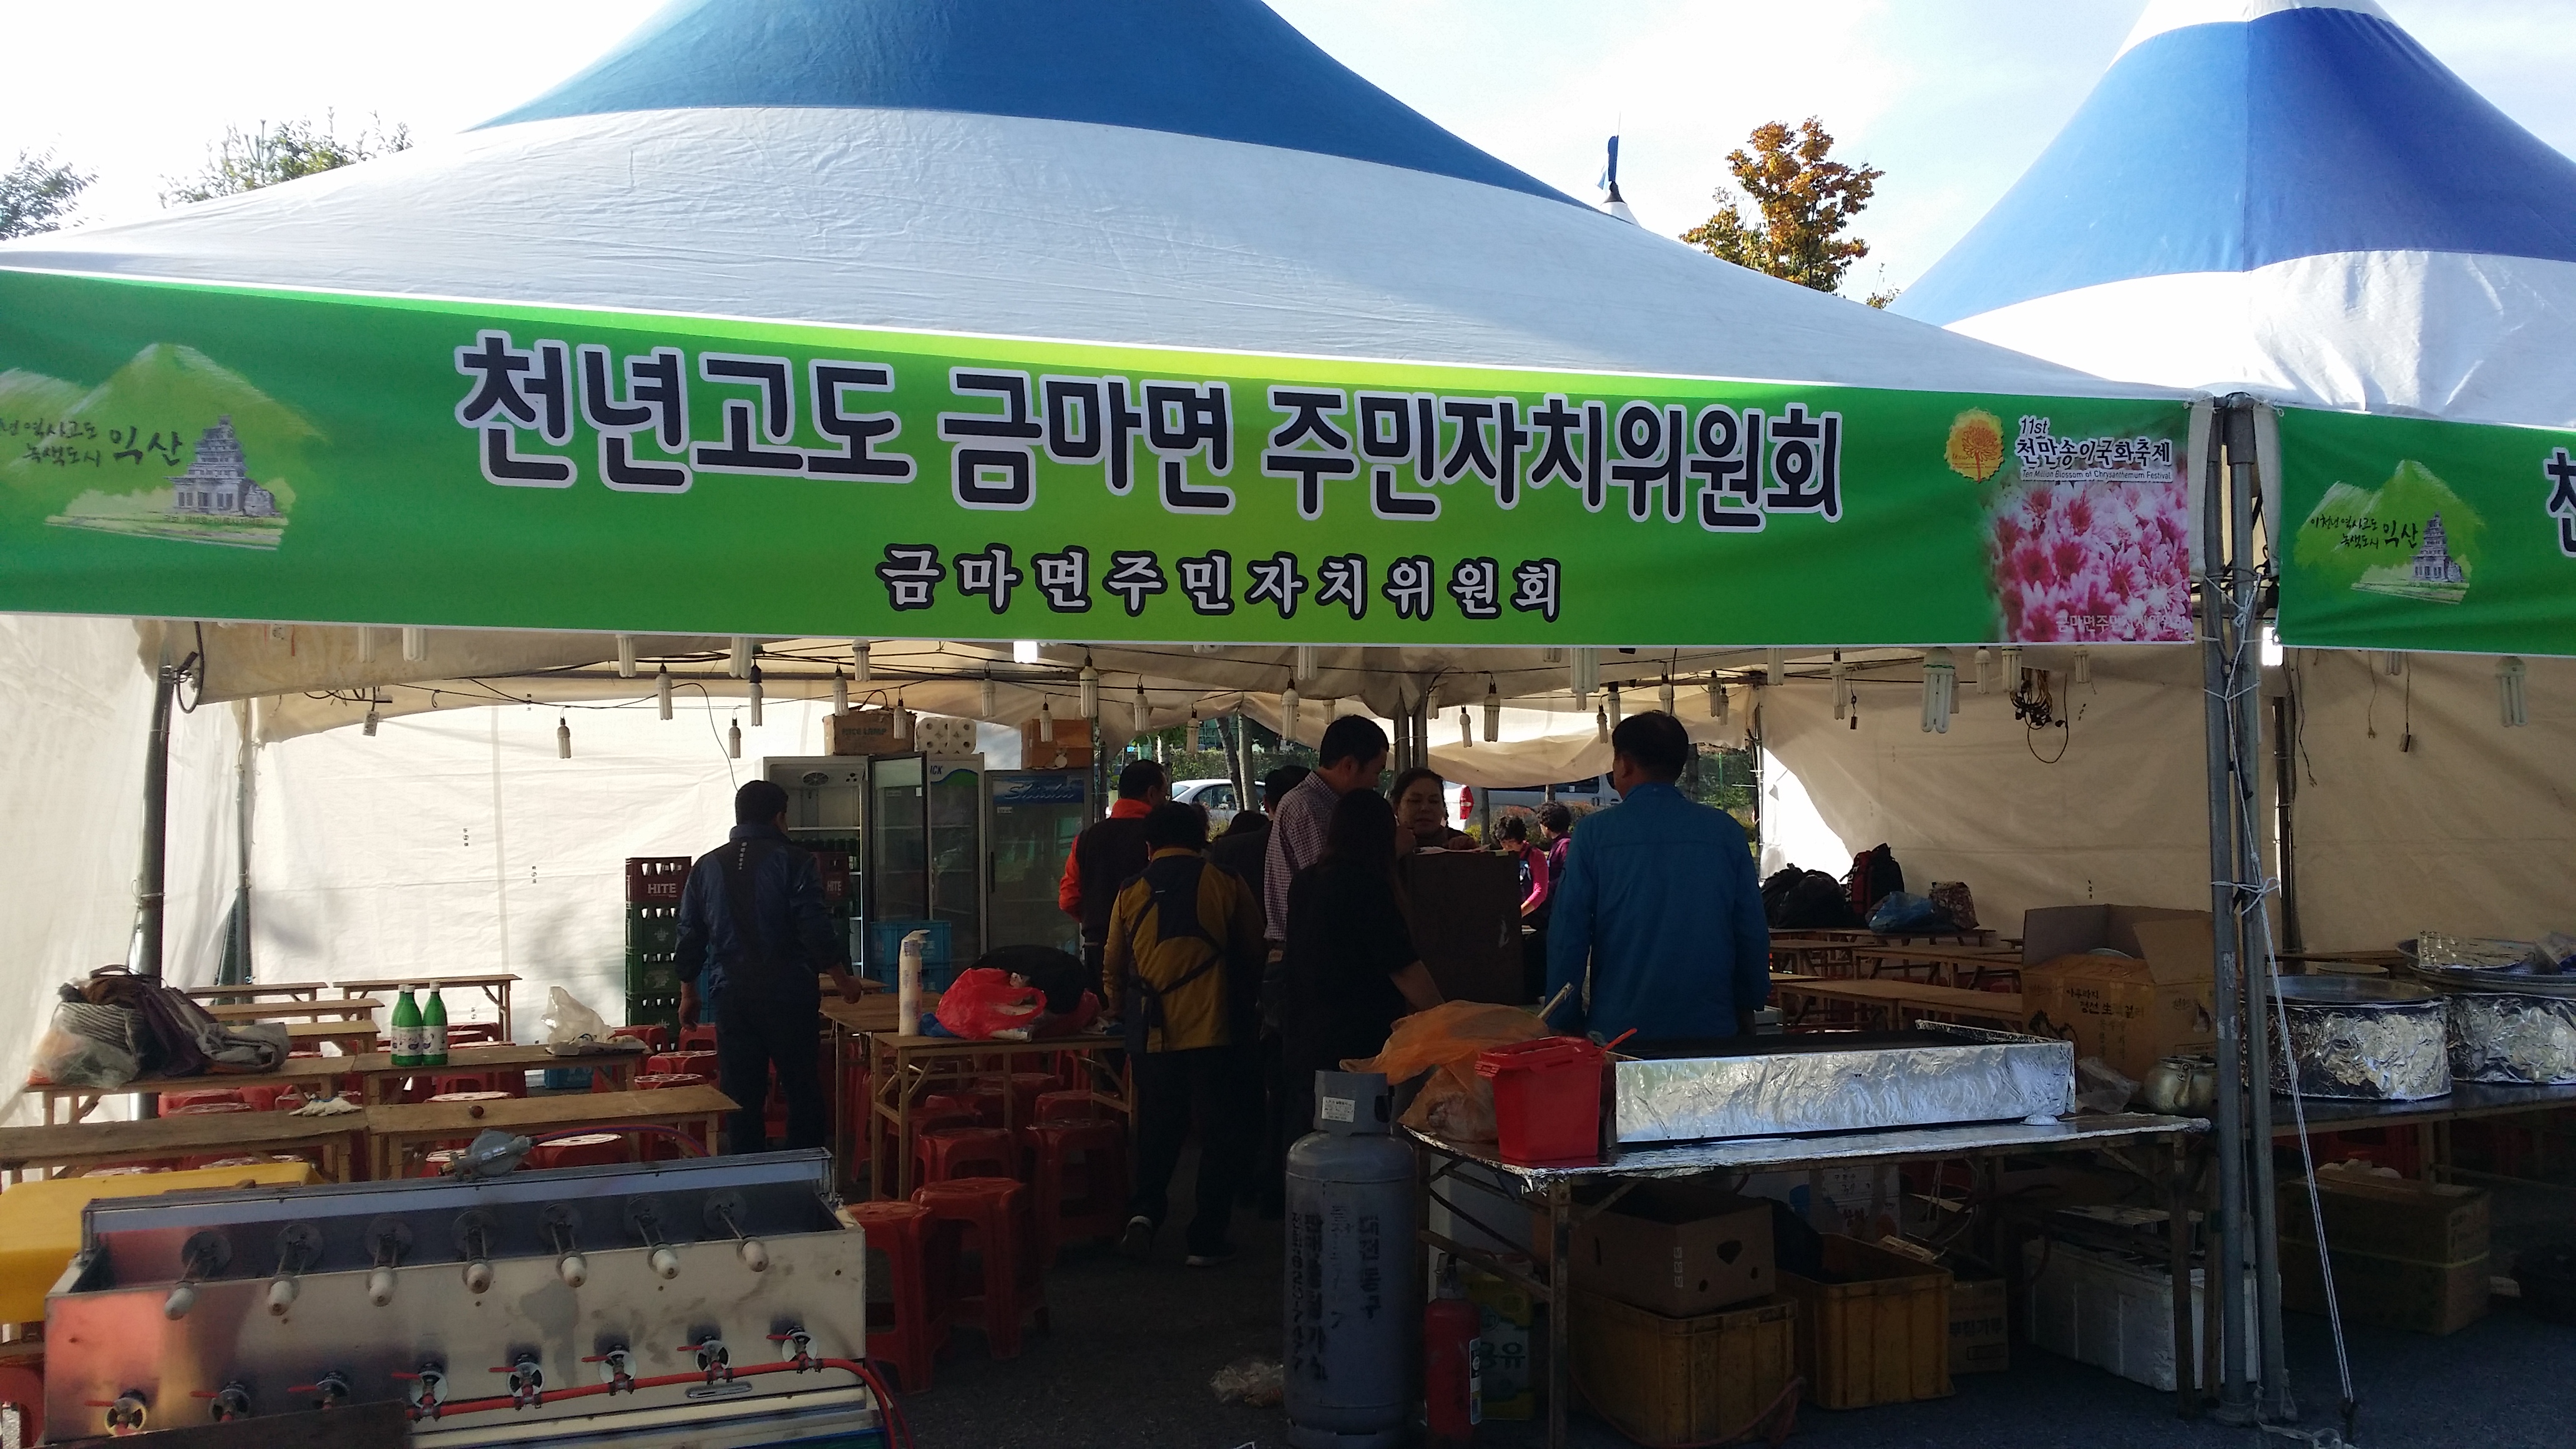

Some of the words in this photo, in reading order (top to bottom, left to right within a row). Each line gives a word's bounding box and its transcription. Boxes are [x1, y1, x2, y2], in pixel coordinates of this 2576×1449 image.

[459, 334, 913, 490] 천년고도
[941, 371, 1233, 512] 금마면
[1263, 388, 1840, 530] 주민자치위원회
[2021, 418, 2048, 434] 11st
[109, 426, 182, 466] 익산
[2017, 437, 2170, 466] 천만송이국화축제
[2094, 471, 2145, 479] Chrysanthemum
[2147, 471, 2171, 479] Festival
[2341, 516, 2378, 531] 역사고도
[2383, 520, 2419, 549] 익산
[2341, 533, 2379, 549] 녹색도시
[877, 544, 1559, 622] 금마면주민자치위원회
[648, 883, 676, 894] HITE
